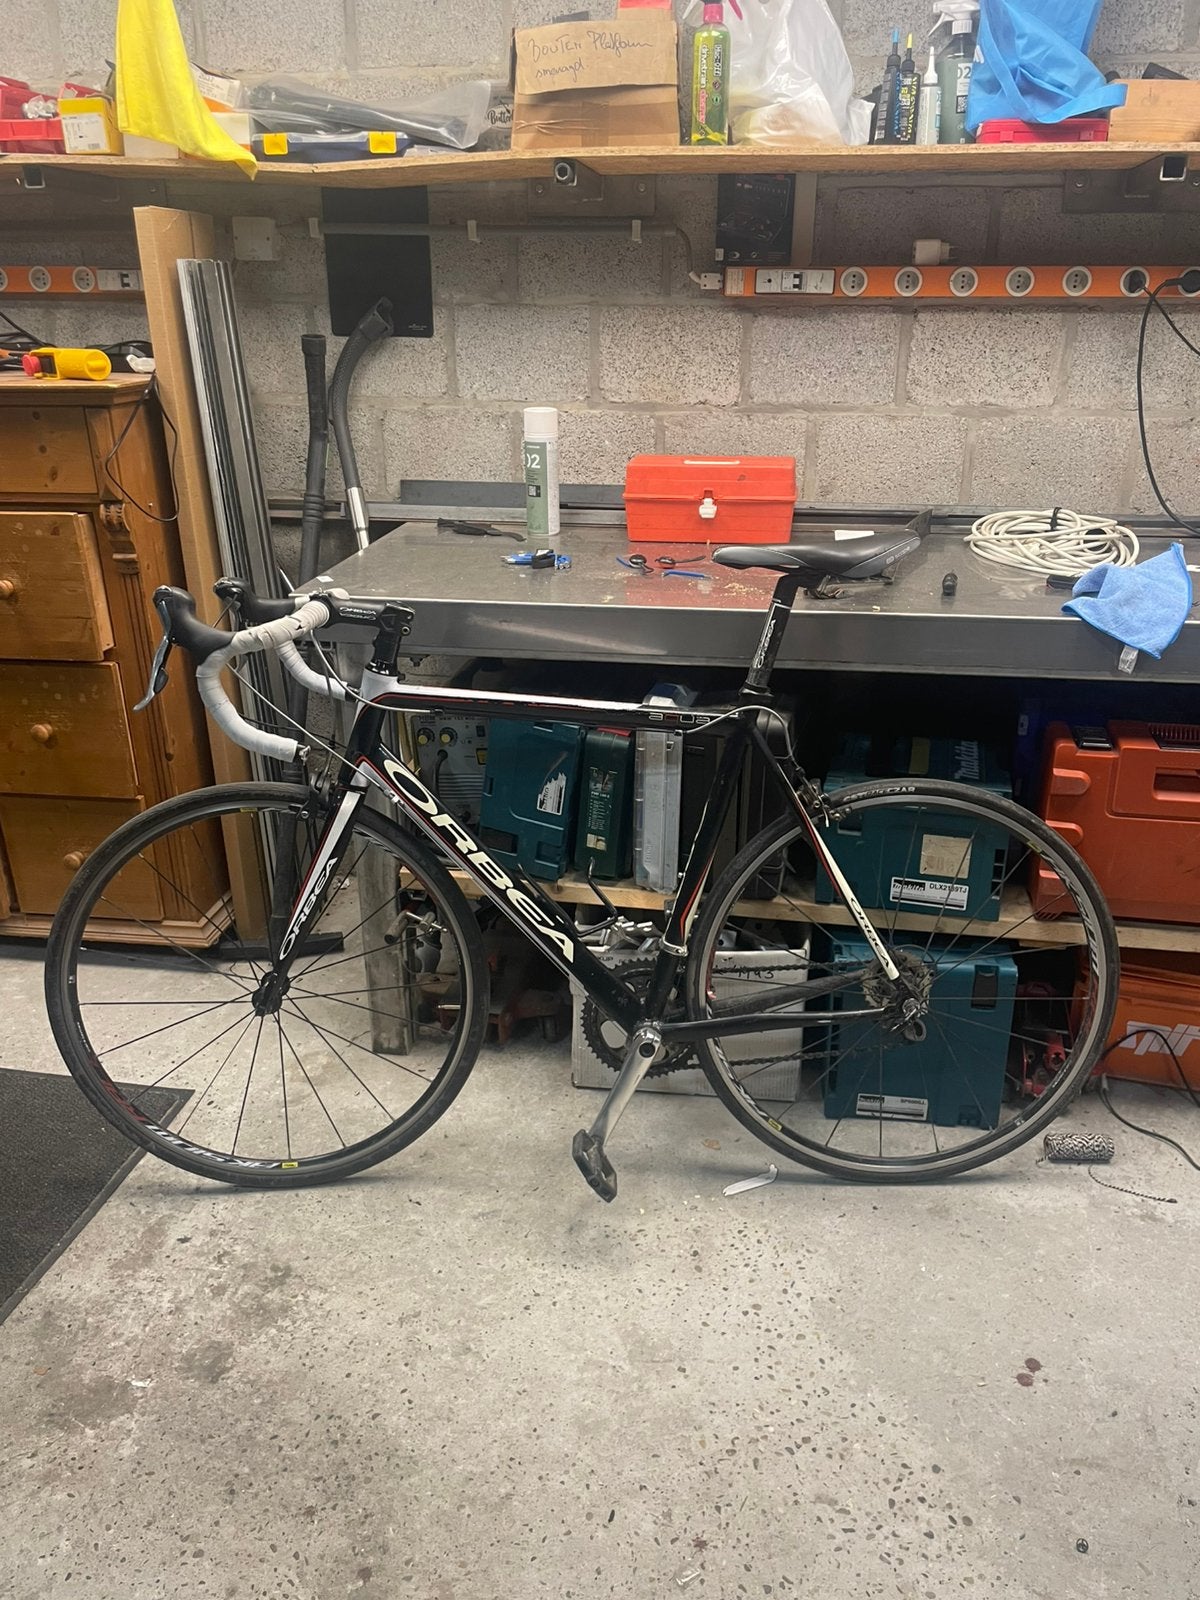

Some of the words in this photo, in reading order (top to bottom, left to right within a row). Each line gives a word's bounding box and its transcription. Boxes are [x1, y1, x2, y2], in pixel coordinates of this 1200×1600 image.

[278, 856, 339, 962] ORBEA
[382, 758, 576, 965] ORBEA
[849, 895, 891, 969] ORBEA
